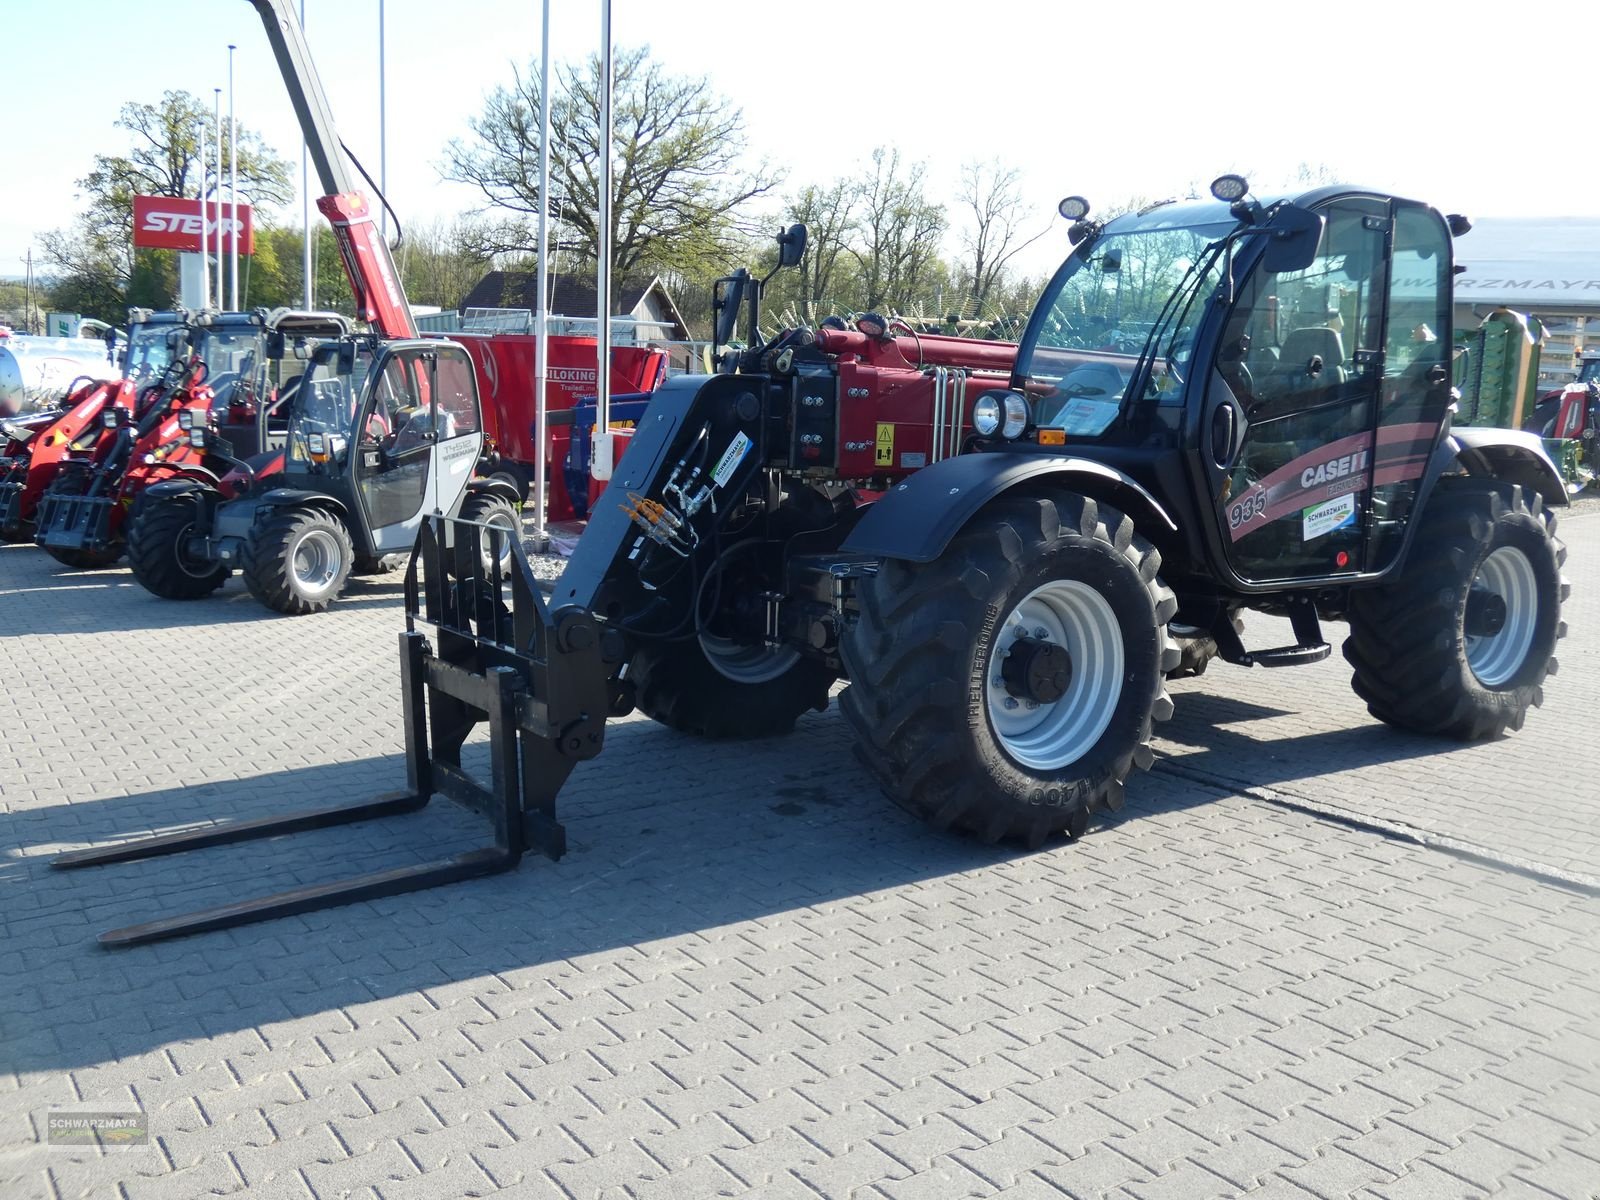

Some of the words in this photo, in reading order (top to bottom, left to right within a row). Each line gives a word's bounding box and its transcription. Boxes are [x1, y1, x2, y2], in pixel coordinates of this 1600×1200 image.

[142, 211, 245, 239] STEYR
[715, 440, 742, 477] SCHWARZMAYR
[1301, 456, 1350, 488] CASE
[1230, 488, 1267, 530] 935
[1307, 503, 1348, 522] SCHWARZMAYR
[967, 602, 999, 730] TRELLEBORG
